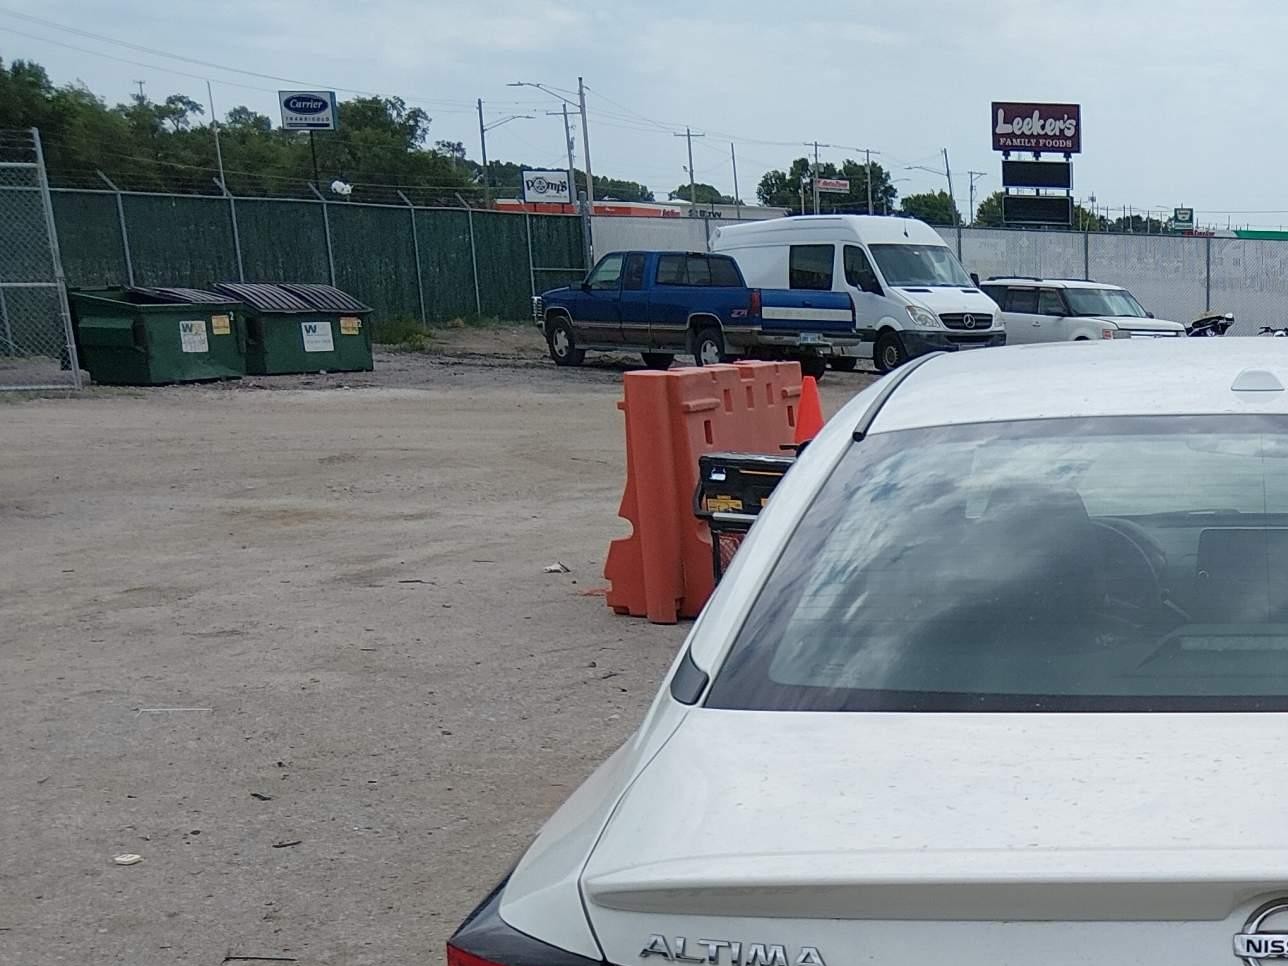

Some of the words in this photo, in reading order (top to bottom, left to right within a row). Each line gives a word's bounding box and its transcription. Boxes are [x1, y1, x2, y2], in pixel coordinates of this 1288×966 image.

[290, 99, 323, 109] Carrier
[995, 108, 1077, 137] Leeker's
[999, 138, 1038, 147] FAMILY
[1040, 139, 1072, 148] FOODS
